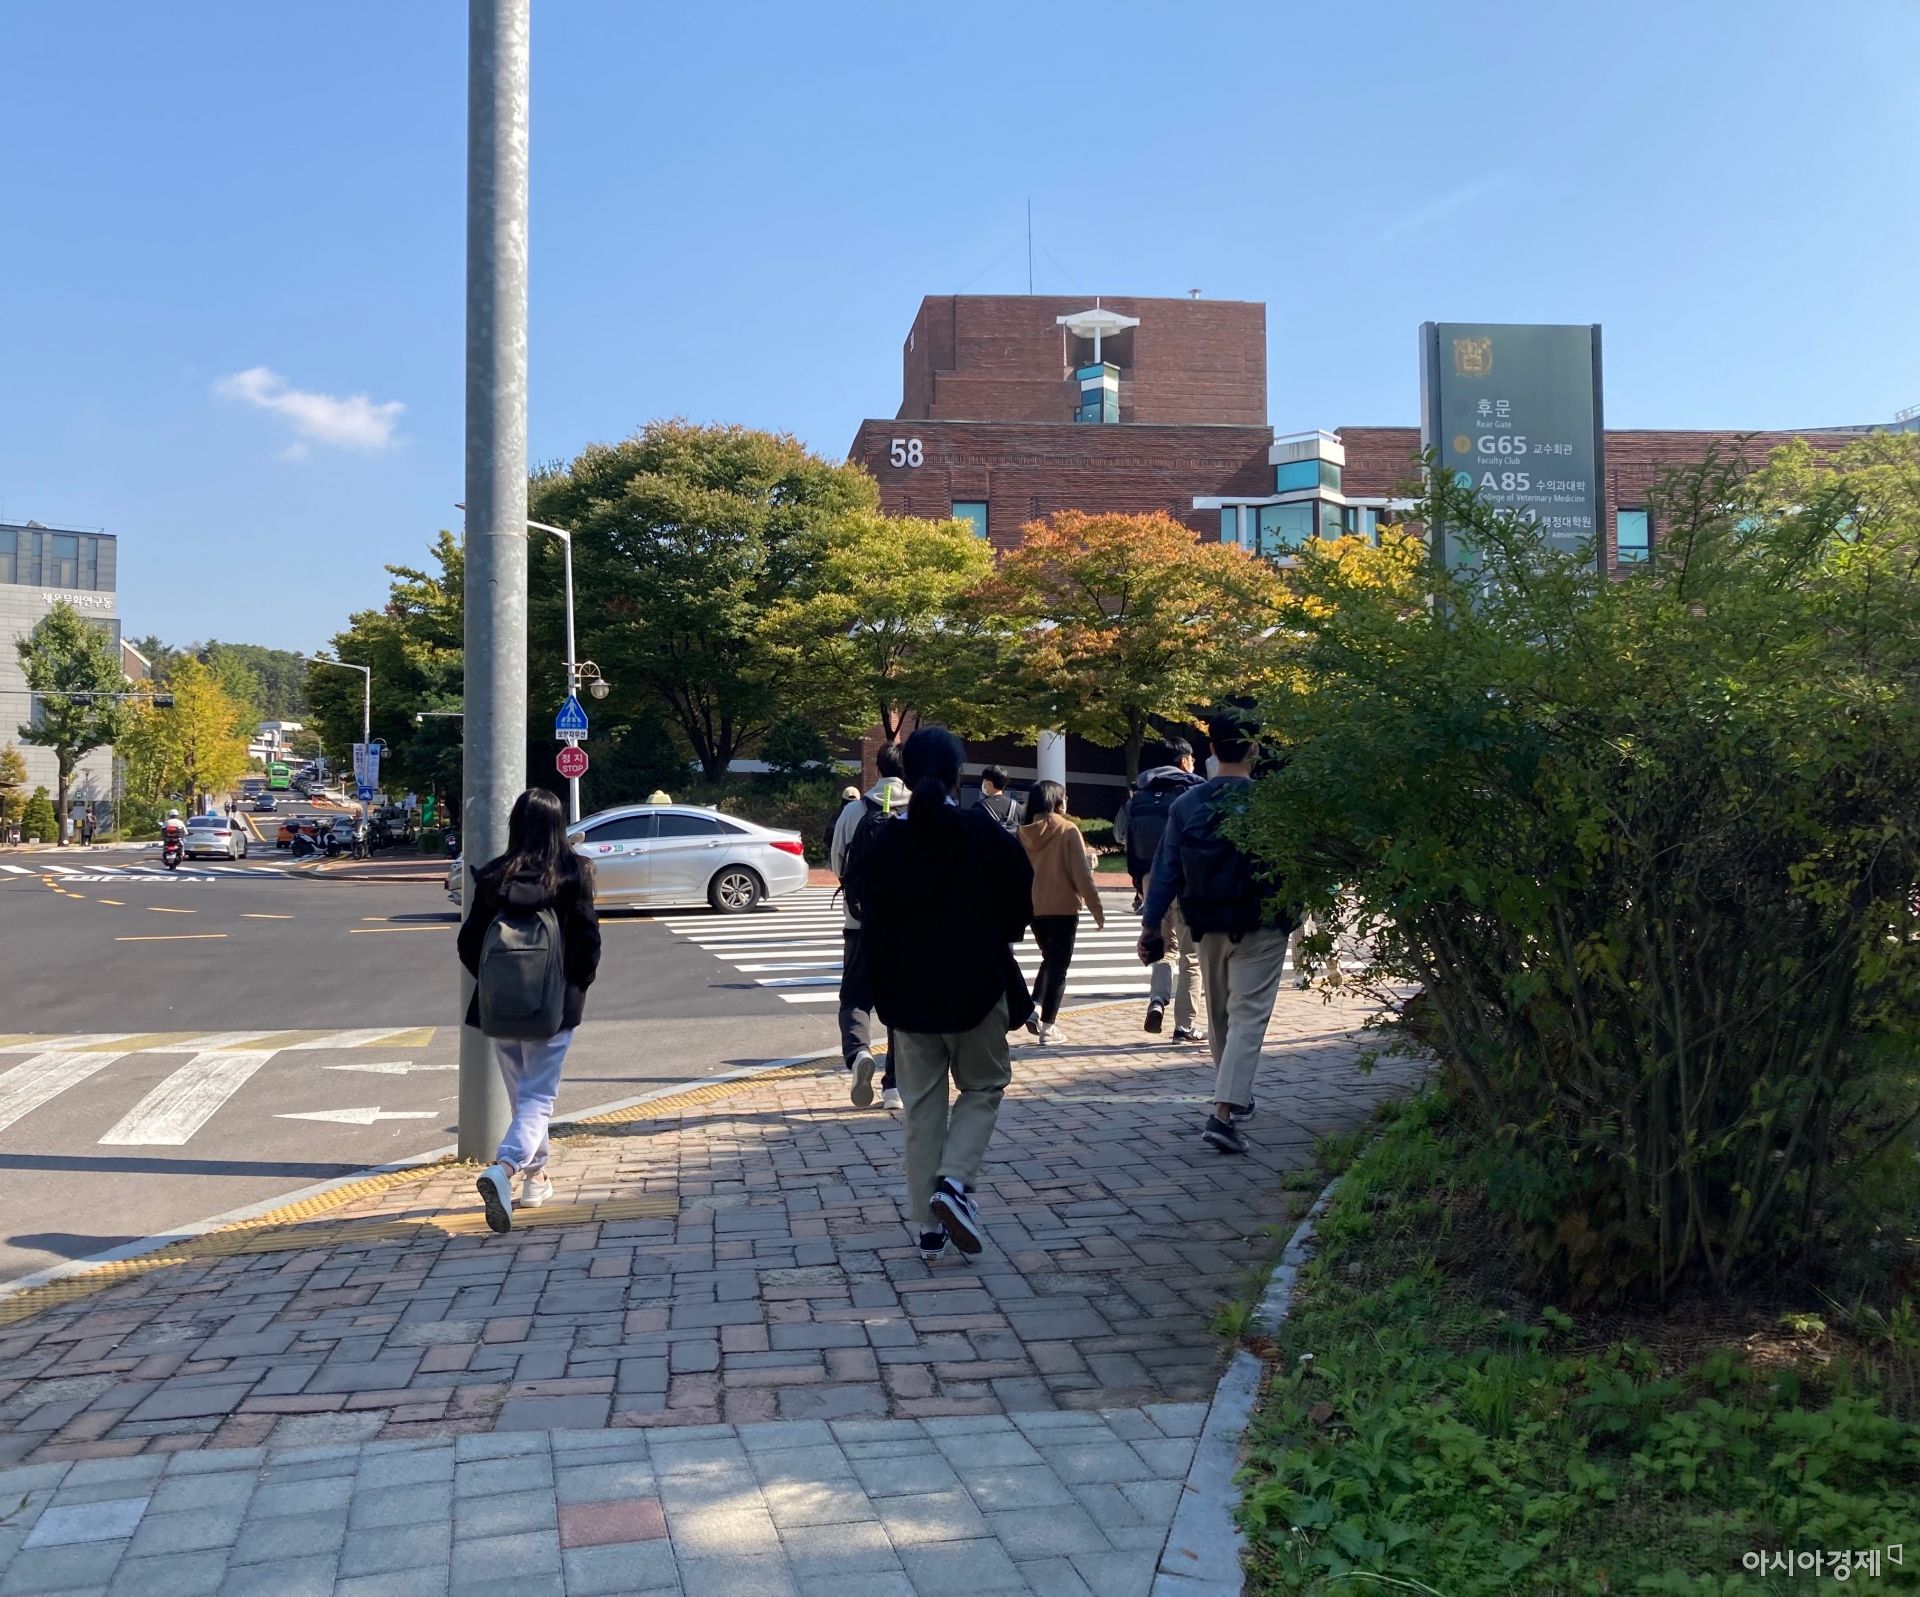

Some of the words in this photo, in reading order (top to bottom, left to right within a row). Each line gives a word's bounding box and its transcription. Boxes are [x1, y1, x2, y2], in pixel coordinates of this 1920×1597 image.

[1477, 399, 1511, 418] 후문
[1477, 420, 1493, 429] Rear
[1495, 420, 1512, 429] Gate
[1477, 435, 1527, 455] G65
[1533, 443, 1573, 455] 교수회관
[890, 438, 924, 468] 58
[1477, 456, 1503, 466] Faculty
[1504, 456, 1521, 465] Club
[1480, 471, 1530, 491] A85
[1536, 480, 1586, 492] 수의과대학
[1506, 493, 1514, 501] of
[1515, 493, 1551, 503] Veterinary
[1553, 494, 1586, 503] Medicine
[561, 753, 583, 764] 정지
[562, 765, 584, 773] STOP
